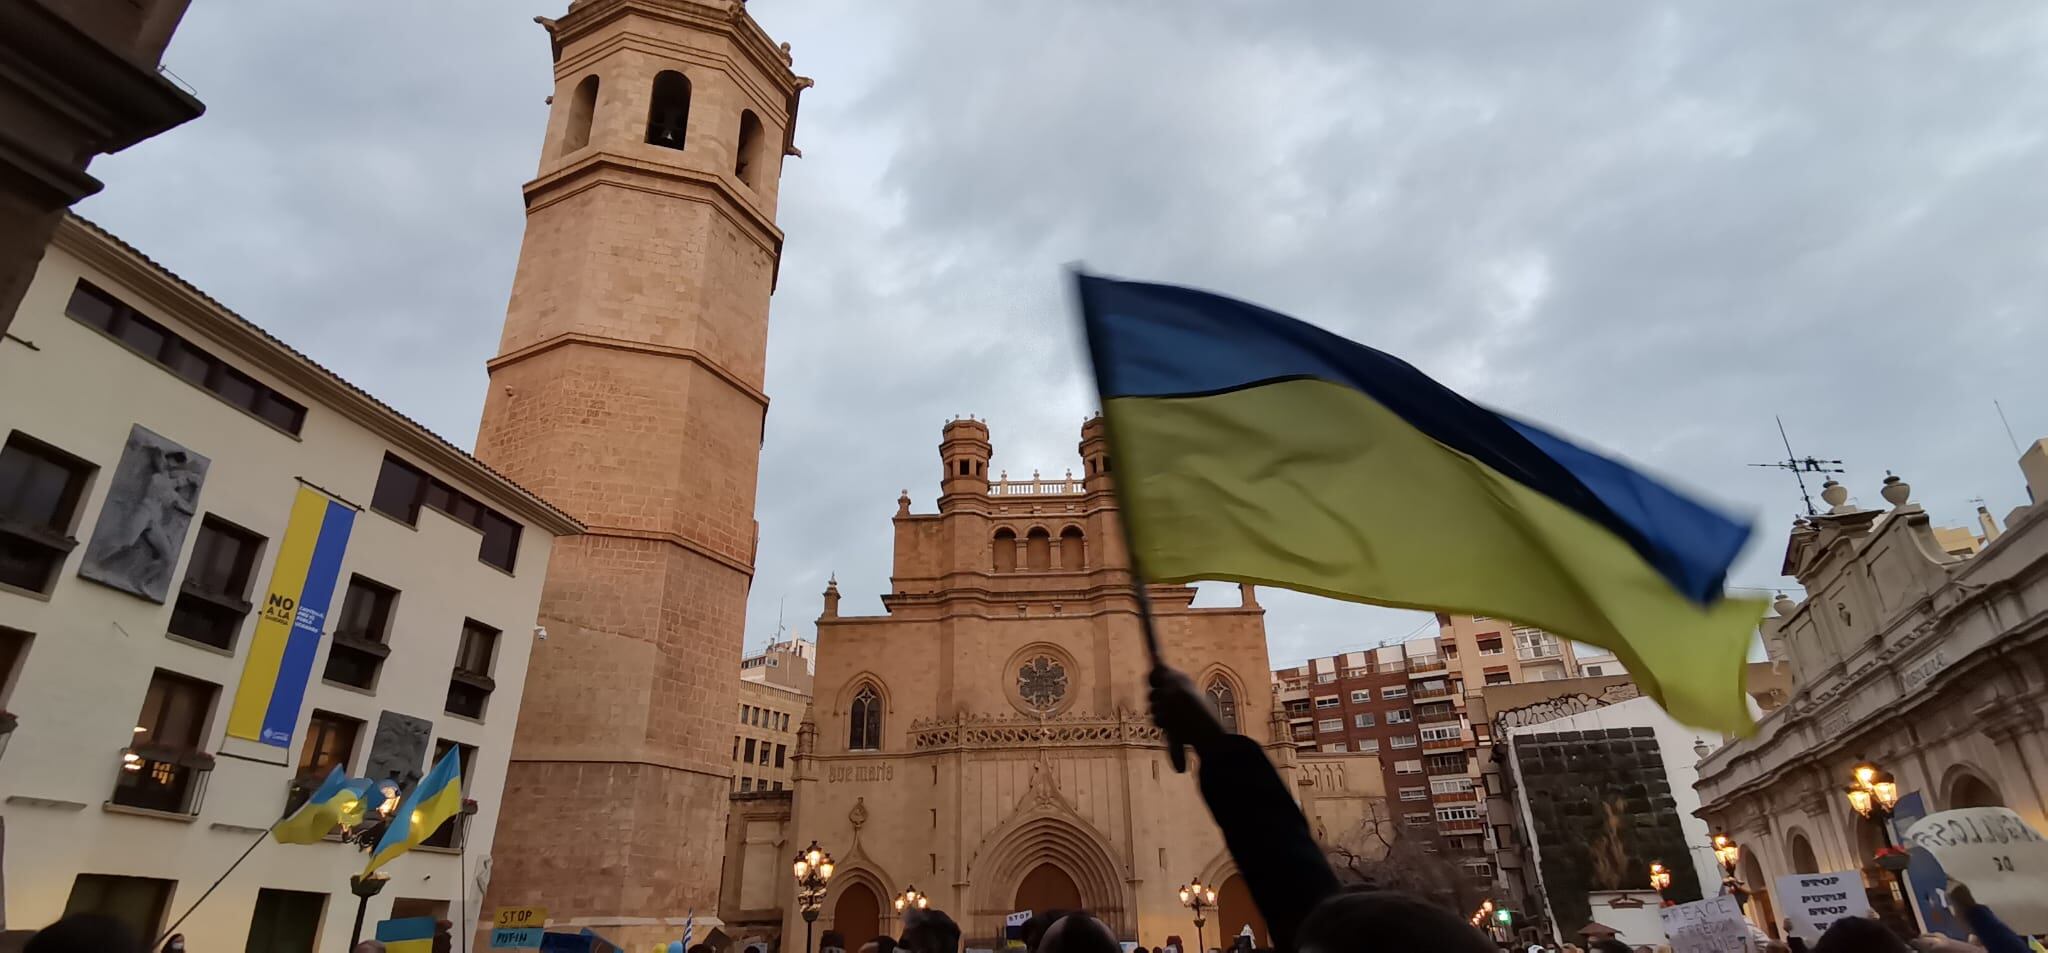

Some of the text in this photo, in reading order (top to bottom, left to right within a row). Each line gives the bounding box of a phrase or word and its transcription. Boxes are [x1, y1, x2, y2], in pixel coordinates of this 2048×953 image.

[269, 593, 294, 611] NO
[266, 606, 274, 616] A
[278, 609, 290, 621] LA
[1800, 877, 1840, 888] STOP
[1801, 892, 1848, 904] PUTIN
[499, 909, 533, 925] STOP
[1808, 905, 1848, 916] STOP
